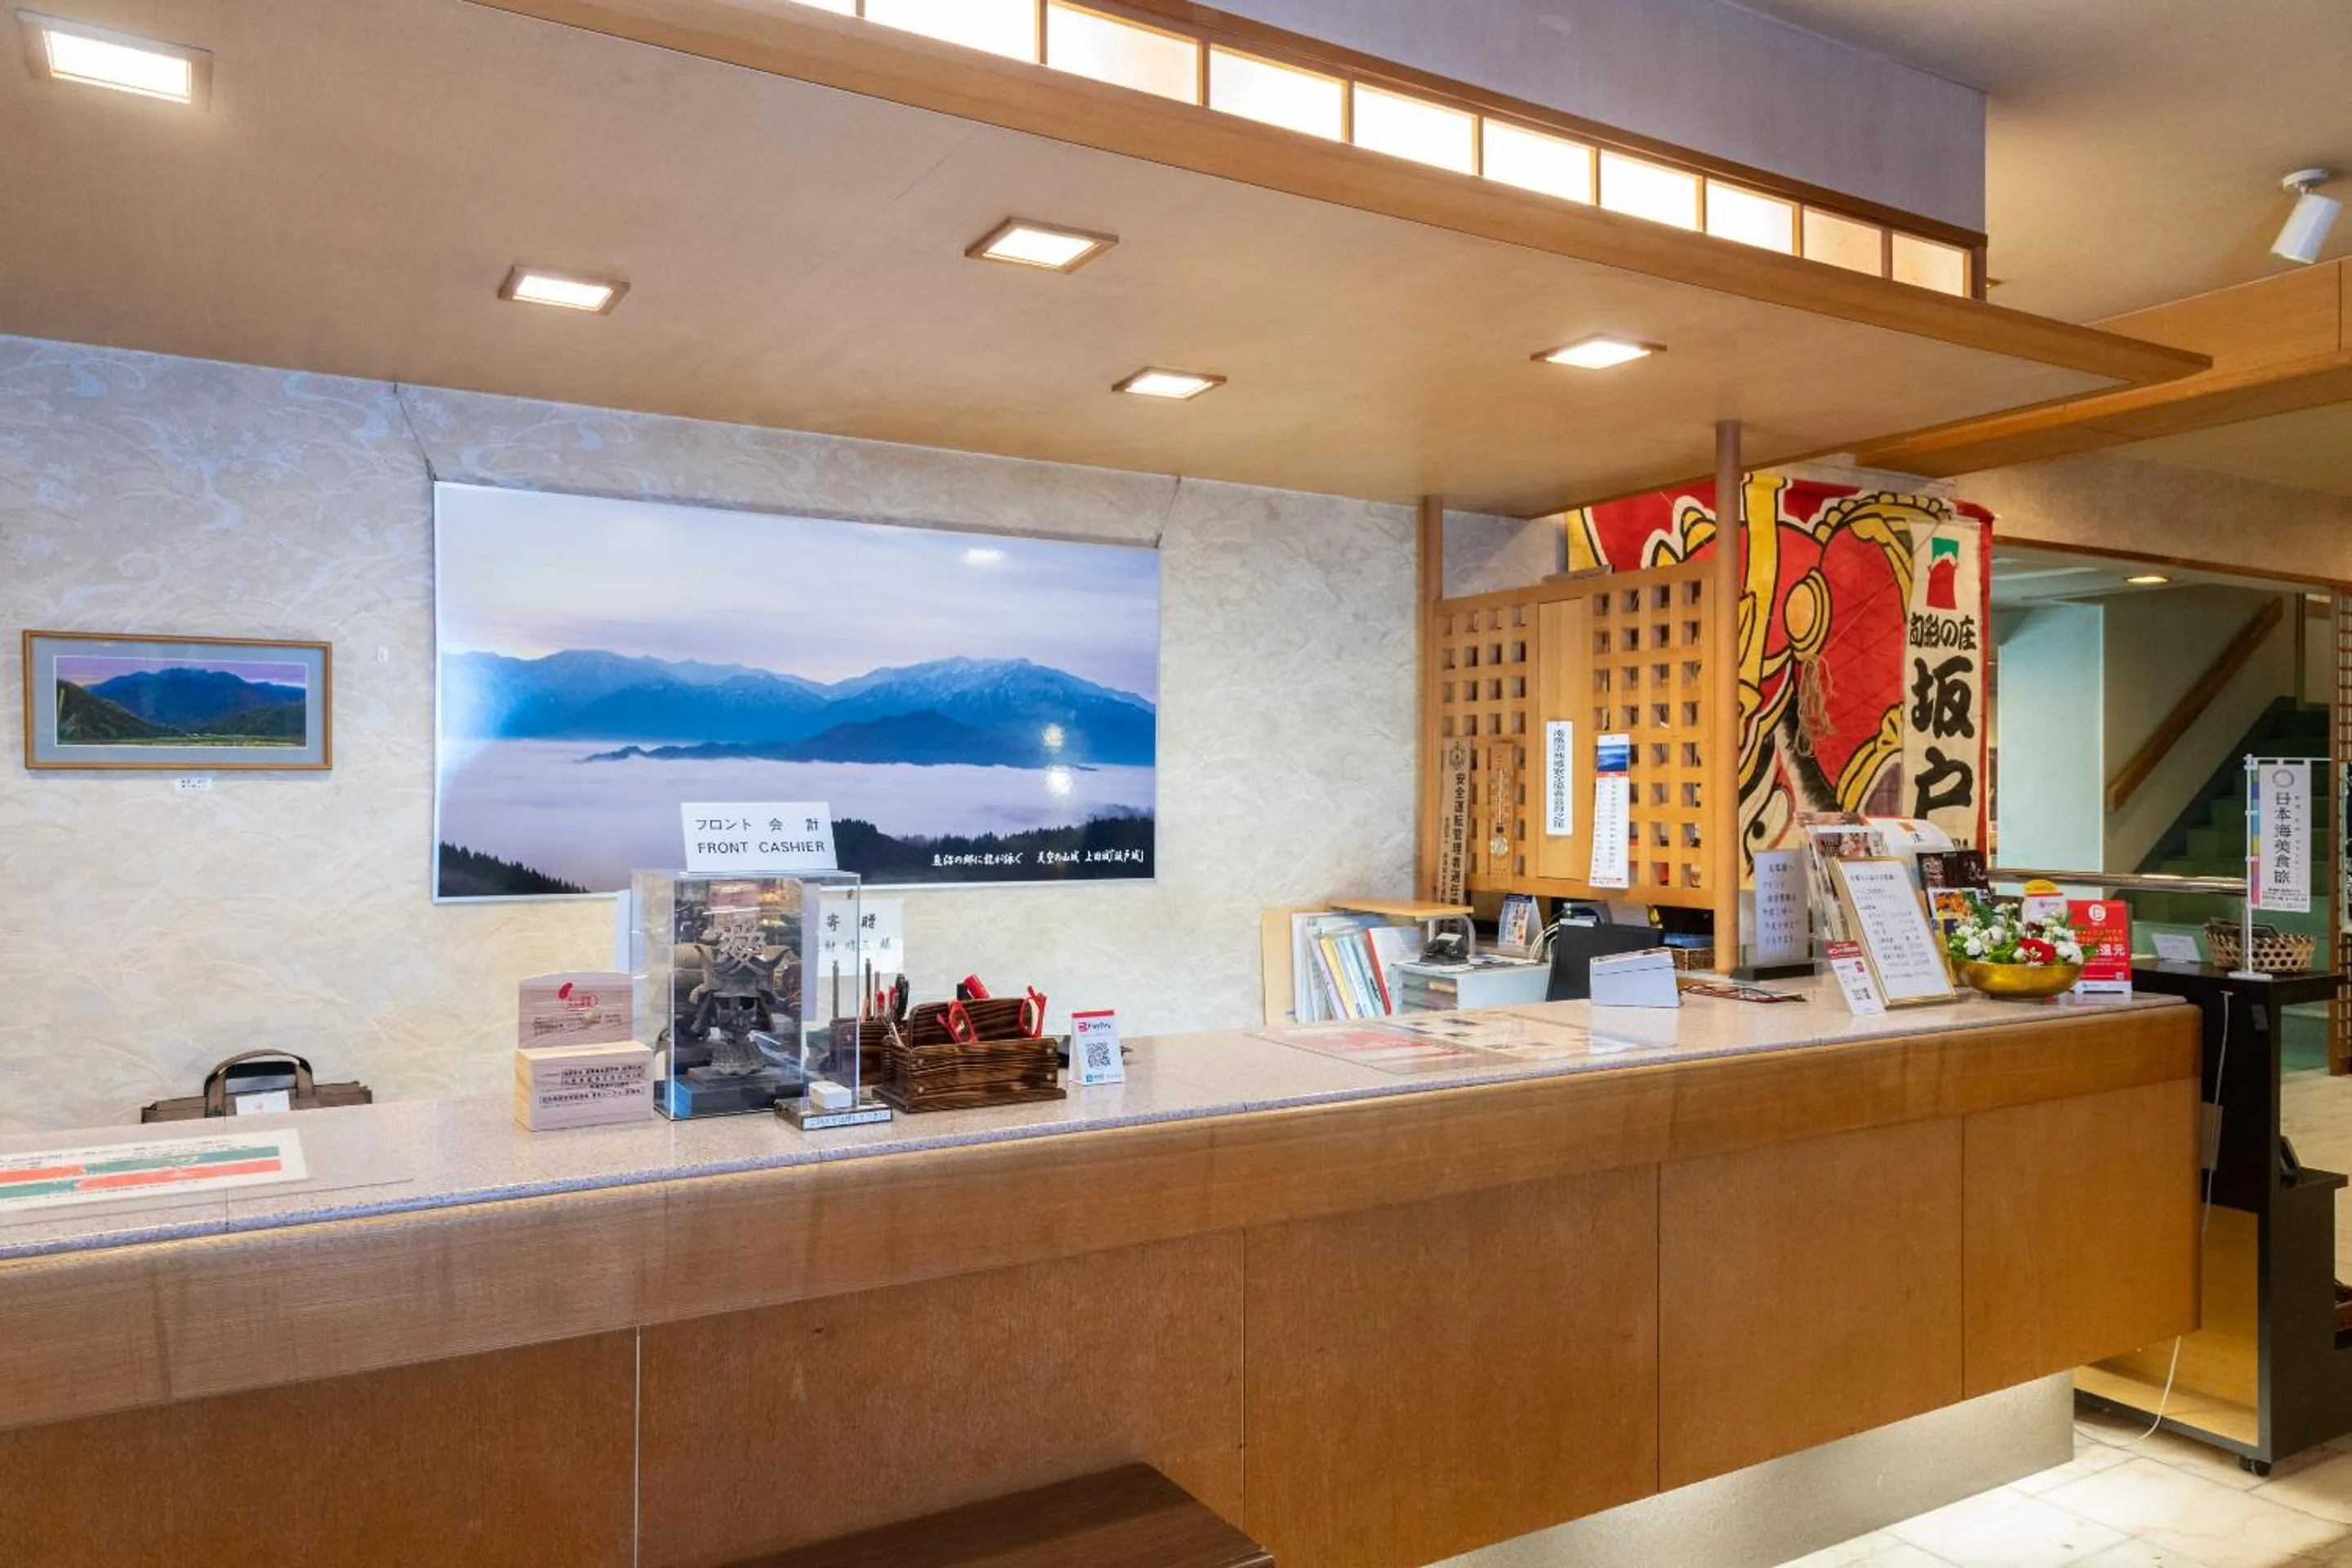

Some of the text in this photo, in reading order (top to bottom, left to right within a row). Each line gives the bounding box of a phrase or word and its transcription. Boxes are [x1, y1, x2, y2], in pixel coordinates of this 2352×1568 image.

[1911, 656, 1976, 851] 坂戸
[696, 818, 752, 831] フロント
[697, 841, 826, 854] FRONT CASHIER
[2274, 791, 2292, 884] 日本海美食旅
